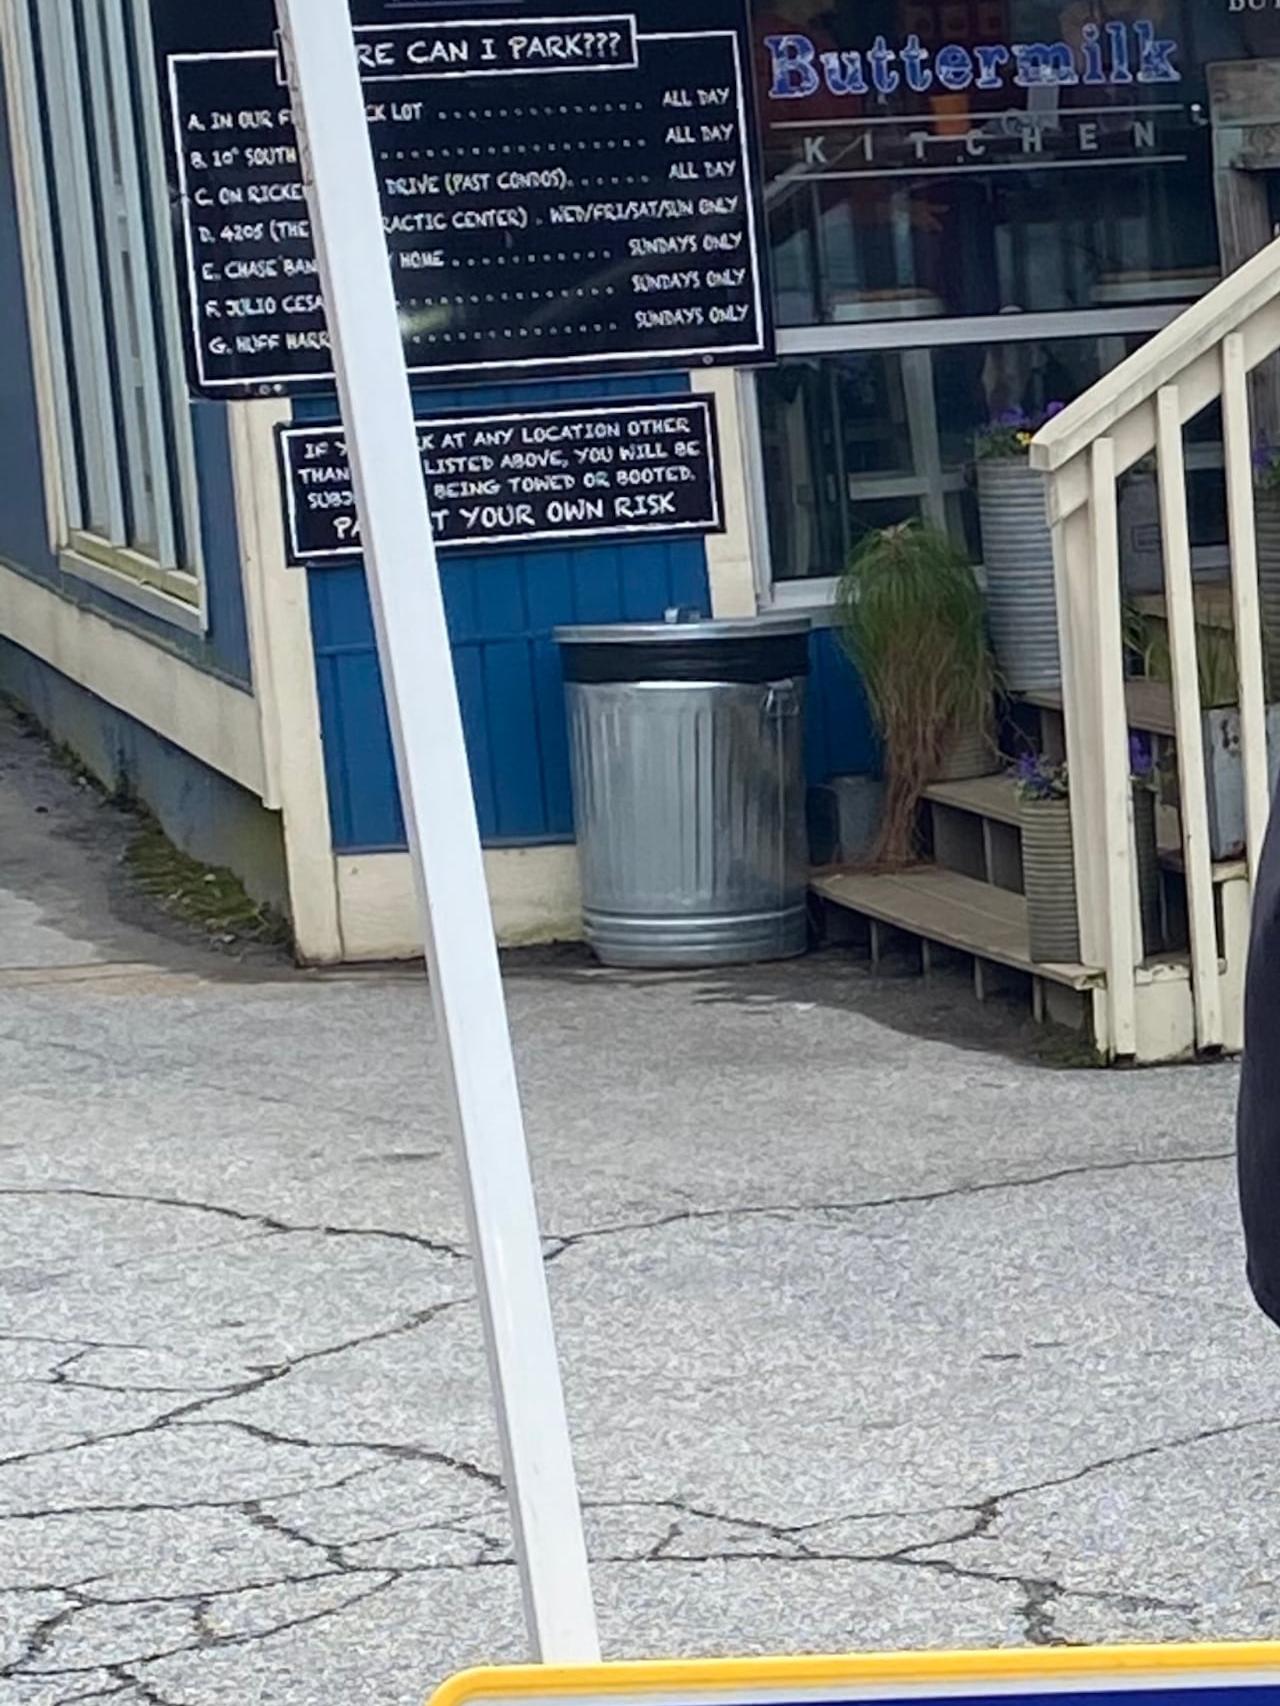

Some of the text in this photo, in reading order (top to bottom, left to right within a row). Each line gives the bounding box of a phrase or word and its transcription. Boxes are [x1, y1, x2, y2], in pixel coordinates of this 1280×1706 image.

[407, 39, 468, 63] CAN
[480, 38, 497, 60] I
[508, 32, 621, 60] PARK???
[766, 21, 1181, 98] Buttermilk
[211, 112, 232, 130] IN
[238, 111, 273, 128] OUR
[392, 103, 422, 121] LOT
[662, 90, 692, 107] ALL
[697, 88, 729, 105] DAY
[245, 147, 296, 166] SOUTH
[665, 126, 696, 143] ALL
[701, 124, 733, 142] DAY
[804, 121, 1155, 164] KITCHEN
[219, 186, 242, 204] ON
[247, 184, 304, 203] RICKE
[385, 174, 439, 195] DRIVE
[445, 172, 490, 196] (PAST
[669, 162, 699, 179] ALL
[703, 159, 736, 178] DAY
[270, 220, 310, 241] (THE
[383, 213, 447, 233] RACTIC
[452, 206, 528, 229] CENTER)
[699, 196, 738, 215] ONLY
[224, 259, 278, 279] CHASE
[283, 256, 319, 276] BAN
[400, 250, 445, 269] HOME
[629, 234, 698, 256] SUNDAYS
[703, 232, 742, 251] ONLY
[226, 296, 277, 316] JULIO
[631, 270, 700, 293] SUNDAYS
[706, 268, 745, 287] ONLY
[236, 333, 280, 354] HUFF
[635, 307, 703, 329] SUNDAYS
[709, 304, 748, 324] ONLY
[304, 442, 328, 460] IF
[441, 432, 466, 449] AT
[474, 429, 514, 447] ANY
[521, 422, 620, 443] LOCATION
[627, 417, 691, 437] OTHER
[298, 440, 700, 485] THAN LISTED ABOVE, YOU WILL BE
[434, 479, 500, 499] BEING
[508, 474, 575, 493] TOWED
[583, 470, 610, 488] OR
[616, 465, 696, 486] BOOTED.
[459, 504, 535, 529] YOUR
[547, 498, 603, 523] OWN
[614, 491, 675, 518] RISK
